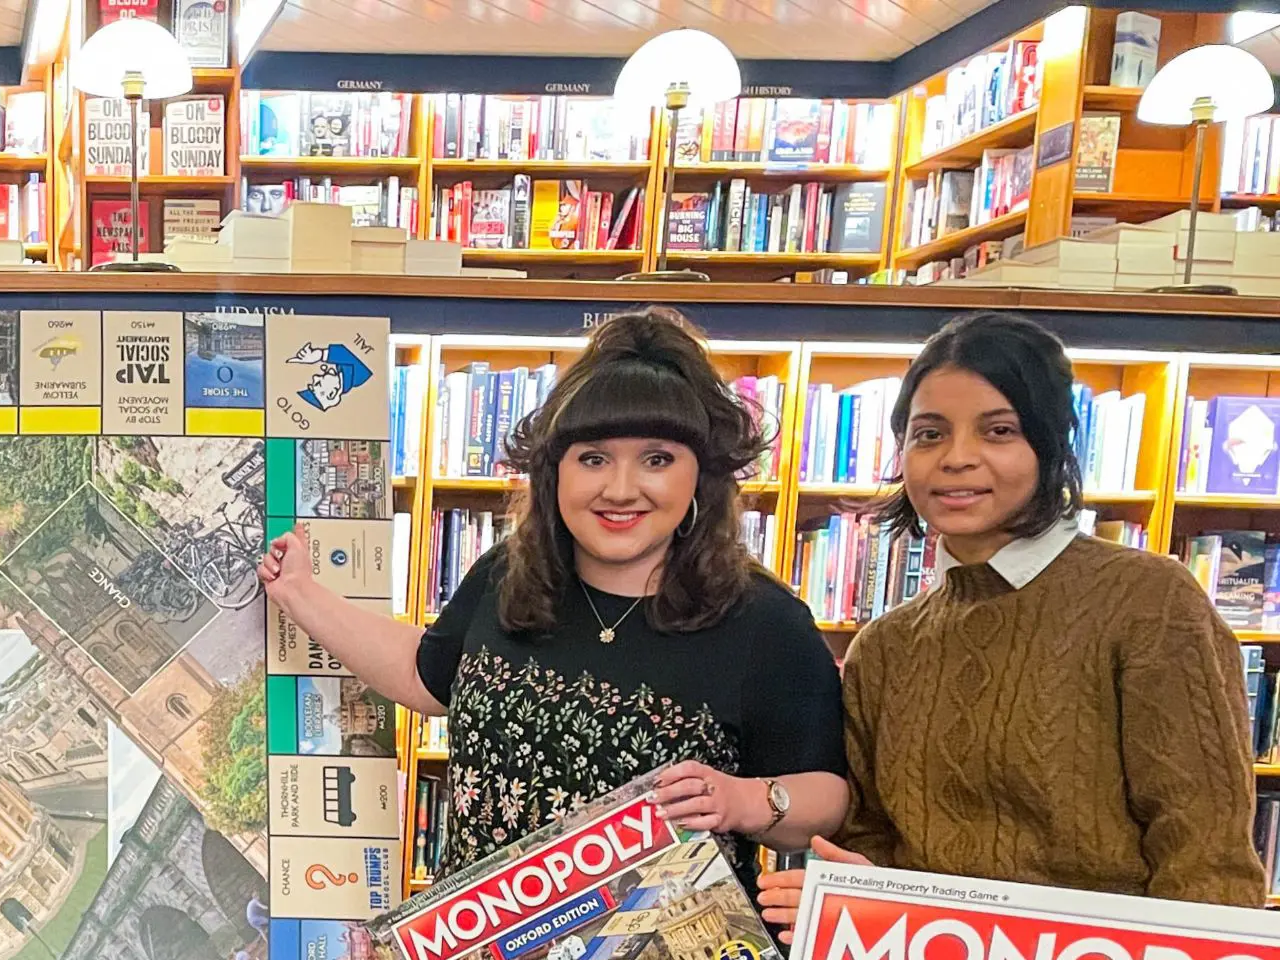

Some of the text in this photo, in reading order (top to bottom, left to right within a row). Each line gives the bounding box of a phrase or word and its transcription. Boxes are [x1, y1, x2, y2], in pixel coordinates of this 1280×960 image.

[337, 80, 382, 90] GERMANY
[545, 83, 590, 93] GERMANY
[103, 100, 122, 117] ON
[186, 104, 205, 120] ON
[171, 127, 222, 144] BLOODY
[171, 150, 221, 168] SUNDAY
[113, 212, 128, 222] THE
[669, 211, 705, 220] BURNING
[678, 224, 694, 234] BIG
[671, 233, 700, 243] HOUSE
[112, 242, 130, 253] AXIS
[353, 332, 375, 355] JAIL
[116, 344, 170, 361] SOCIAL
[116, 363, 170, 384] TAP
[35, 381, 87, 390] SUBMARINE
[203, 387, 248, 397] THE STORE
[43, 391, 79, 400] YELLOW
[118, 397, 169, 405] MOVEMENT
[118, 407, 169, 415] TAP SOCIAL
[276, 396, 310, 431] GO TO
[125, 416, 161, 424] STOP BY
[312, 539, 320, 576] OXFORD
[88, 566, 131, 609] CHANCE
[288, 622, 297, 649] CHEST
[291, 764, 299, 828] PARK AND RIDE
[282, 858, 290, 896] CHANCE
[370, 848, 382, 910] TOP TRUMPS
[827, 873, 999, 901] Fast-Dealing Property Trading Game
[505, 898, 600, 953] OXFORD EDITION
[317, 935, 327, 959] HALL
